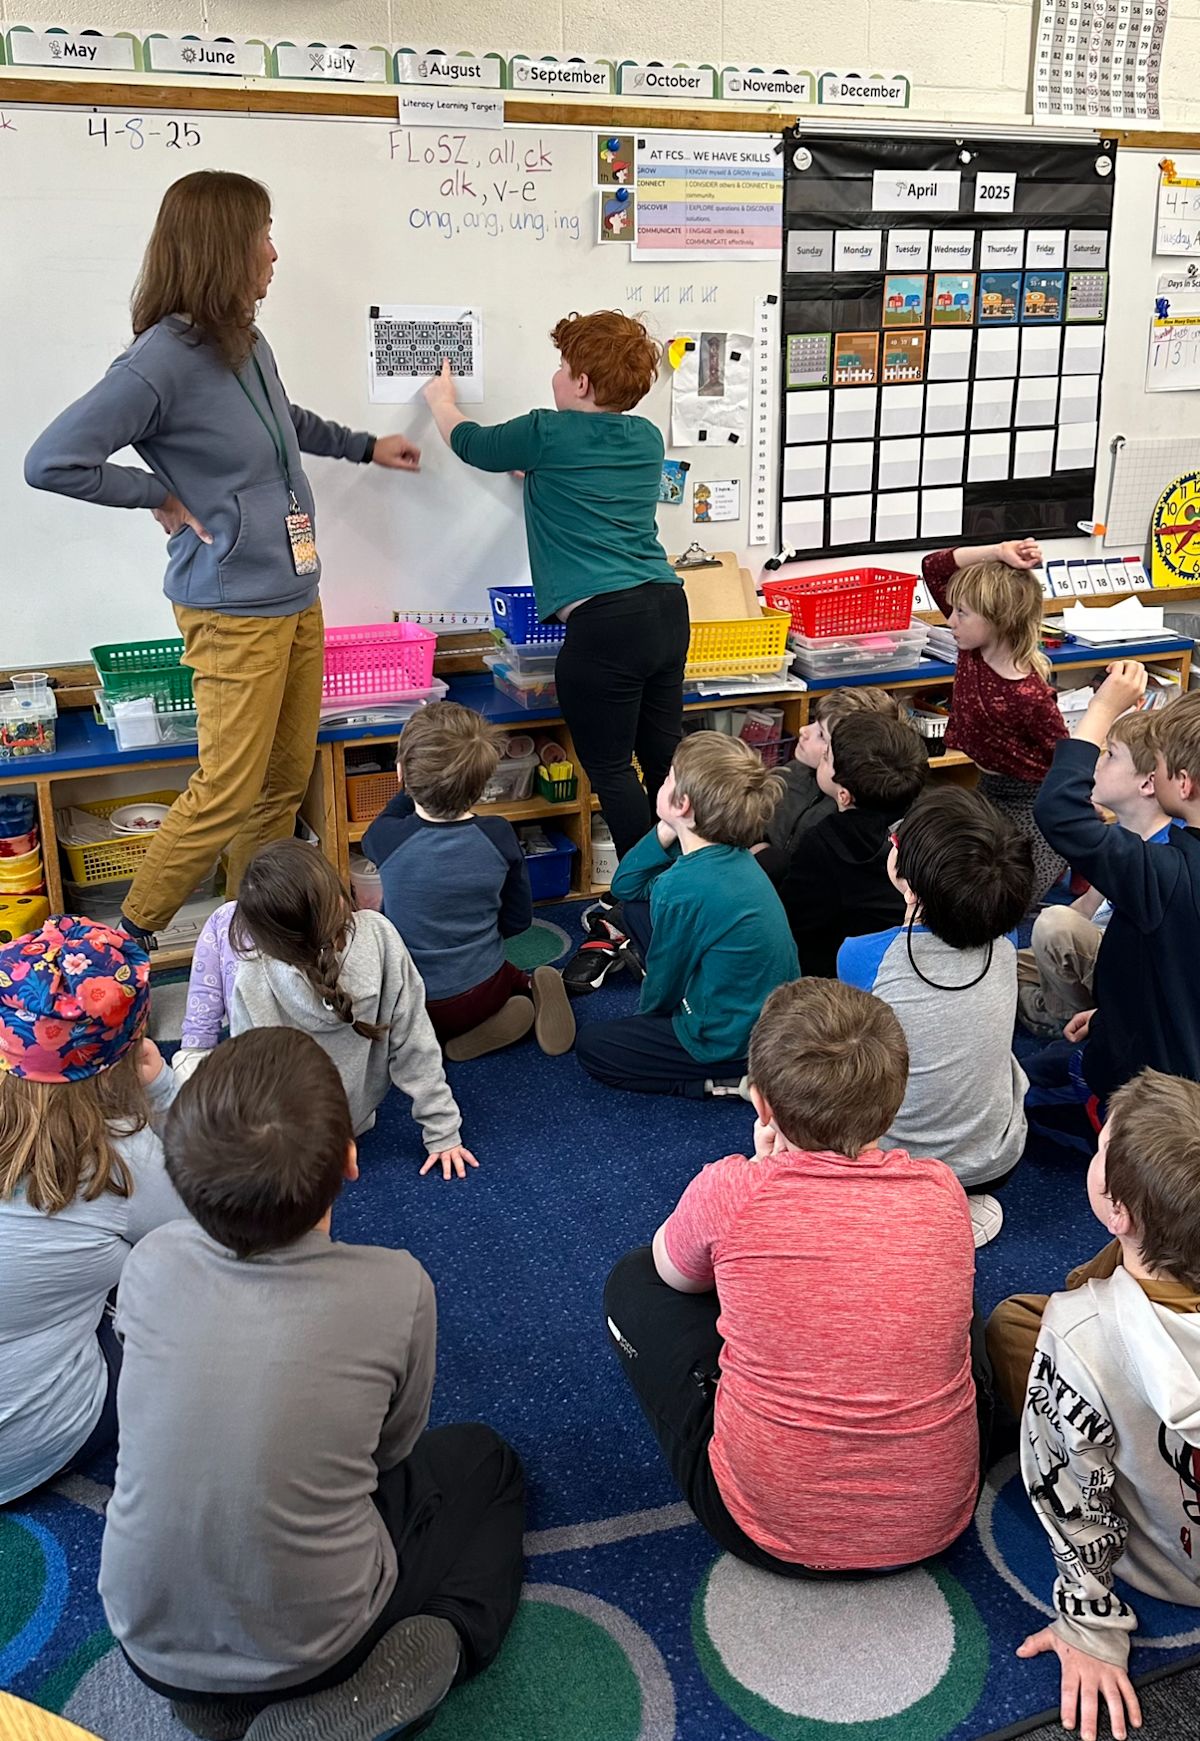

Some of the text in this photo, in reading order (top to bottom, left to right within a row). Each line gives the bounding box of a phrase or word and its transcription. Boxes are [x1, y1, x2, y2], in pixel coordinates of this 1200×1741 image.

[1055, 34, 1063, 42] 72
[1067, 35, 1075, 43] 73
[63, 42, 97, 61] May
[198, 48, 236, 65] June
[326, 55, 356, 74] July
[429, 62, 482, 80] August
[530, 65, 607, 86] September
[645, 73, 702, 89] October
[742, 79, 806, 96] November
[840, 83, 901, 99] December
[402, 99, 434, 110] Literacy
[436, 100, 468, 112] Learning
[87, 117, 201, 150] 4-8-25
[524, 139, 553, 170] ck
[650, 150, 664, 160] AT
[693, 152, 710, 161] WE
[712, 152, 738, 161] HAVE
[740, 153, 771, 163] SKILLS
[907, 183, 938, 200] April
[980, 185, 1010, 200] 2025
[554, 210, 580, 241] ing
[796, 246, 824, 256] Sunday
[843, 245, 873, 256] Monday
[895, 245, 922, 255] Tuesday
[934, 245, 972, 256] Wednesday
[987, 245, 1018, 255] Thursday
[1036, 245, 1055, 255] Friday
[1073, 244, 1101, 254] Saturday
[1168, 280, 1183, 289] Days
[1181, 486, 1187, 499] 11
[1167, 502, 1177, 516] 10
[1165, 542, 1172, 555] 8
[1179, 556, 1186, 568] 7
[1193, 560, 1200, 572] 6
[1058, 581, 1068, 589] 16
[1078, 581, 1087, 589] 17
[1096, 578, 1107, 587] 18
[1116, 577, 1126, 586] 19
[1133, 575, 1145, 584] 20
[915, 596, 922, 604] 9
[1088, 1467, 1108, 1488] BE
